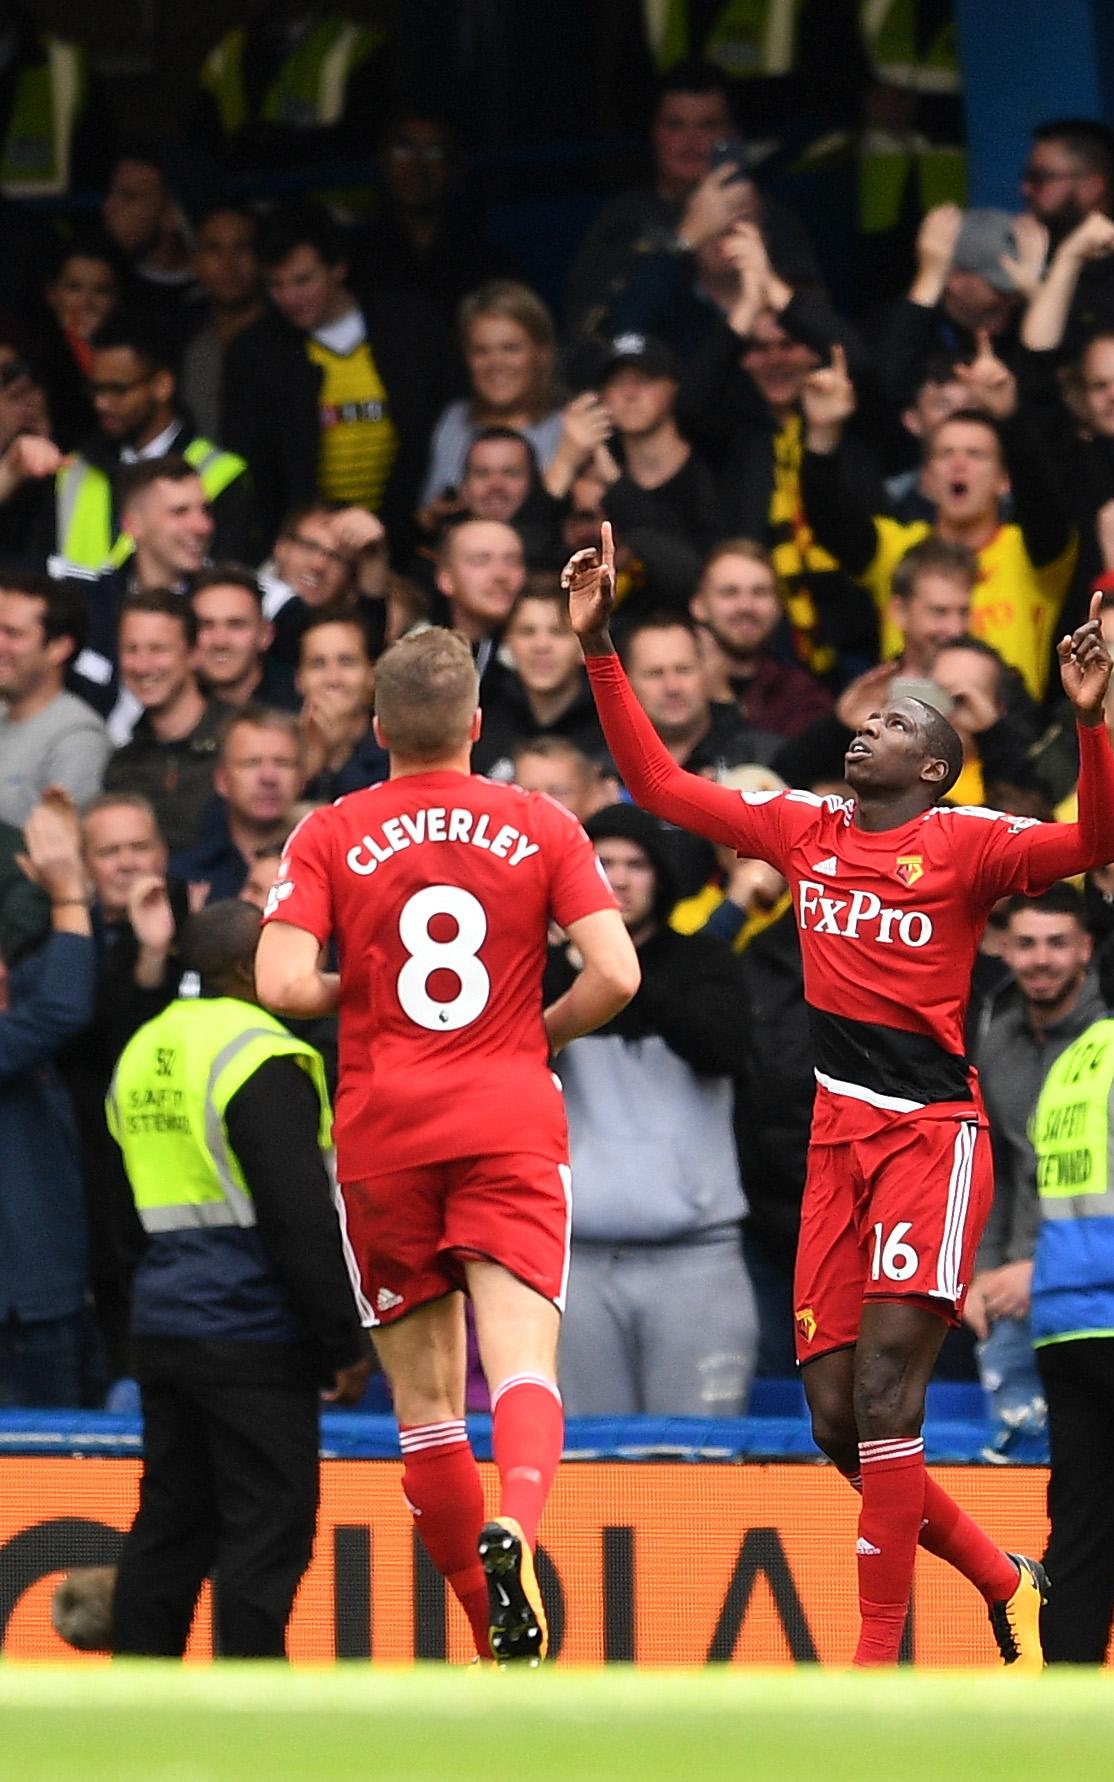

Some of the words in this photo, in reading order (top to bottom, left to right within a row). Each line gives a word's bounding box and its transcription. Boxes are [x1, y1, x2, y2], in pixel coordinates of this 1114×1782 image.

[346, 808, 540, 875] CLEVERLEY
[798, 880, 933, 947] FxPro
[397, 885, 490, 1031] 8
[872, 1222, 919, 1280] 16
